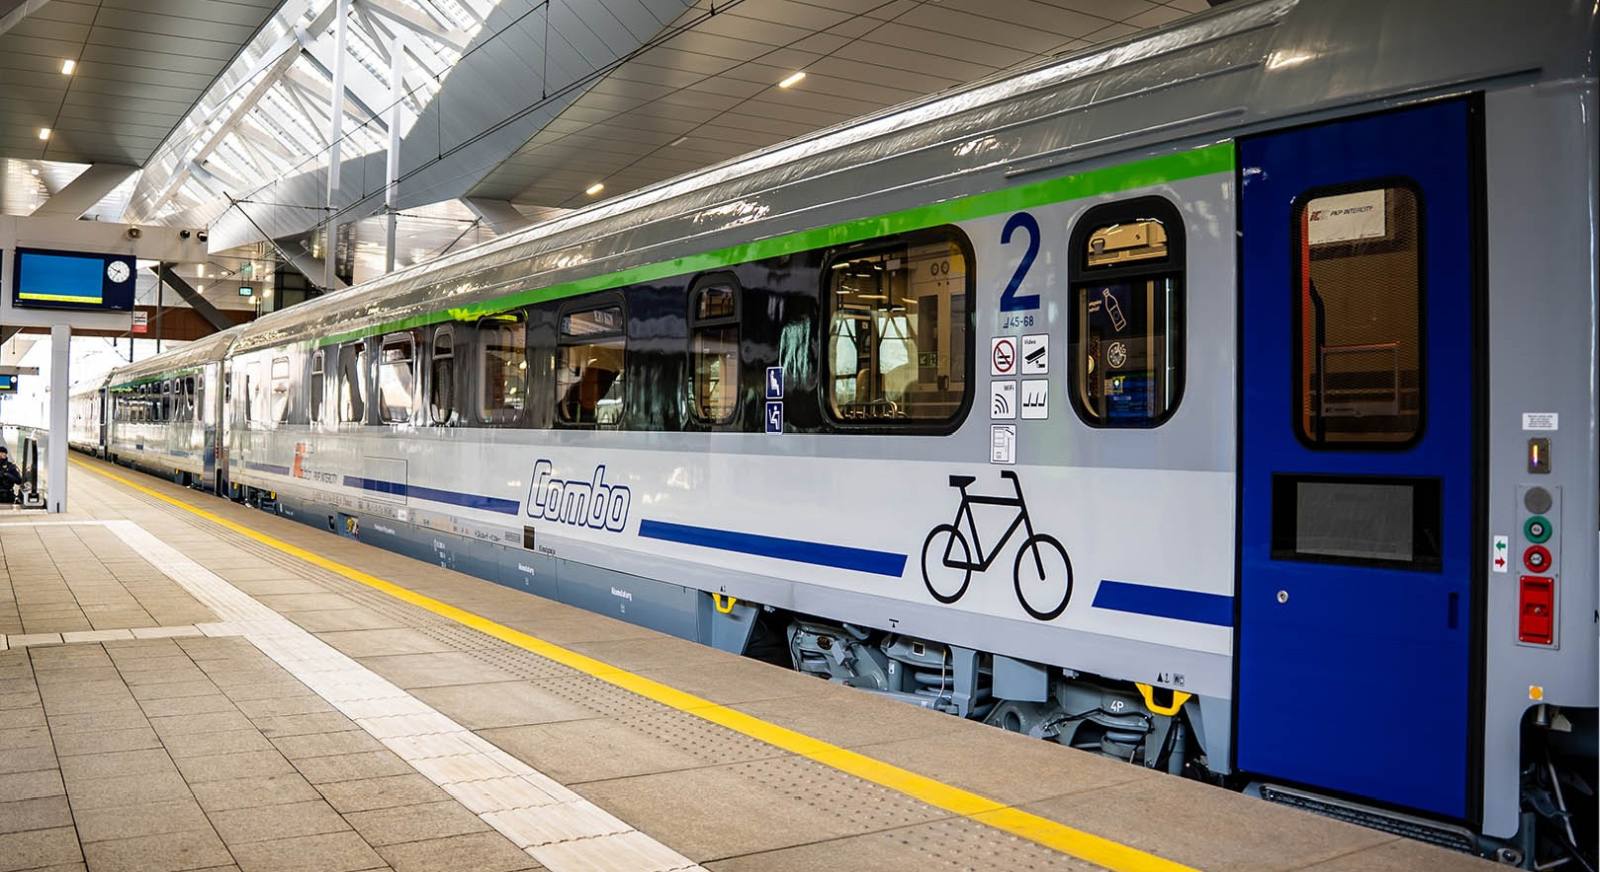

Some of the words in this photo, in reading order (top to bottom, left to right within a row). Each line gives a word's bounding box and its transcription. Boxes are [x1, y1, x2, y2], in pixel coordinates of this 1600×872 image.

[1343, 205, 1373, 215] INTERCITY
[1001, 212, 1040, 312] 2
[1010, 315, 1034, 327] 45-68
[527, 459, 631, 533] Combo
[1110, 700, 1124, 712] 4P
